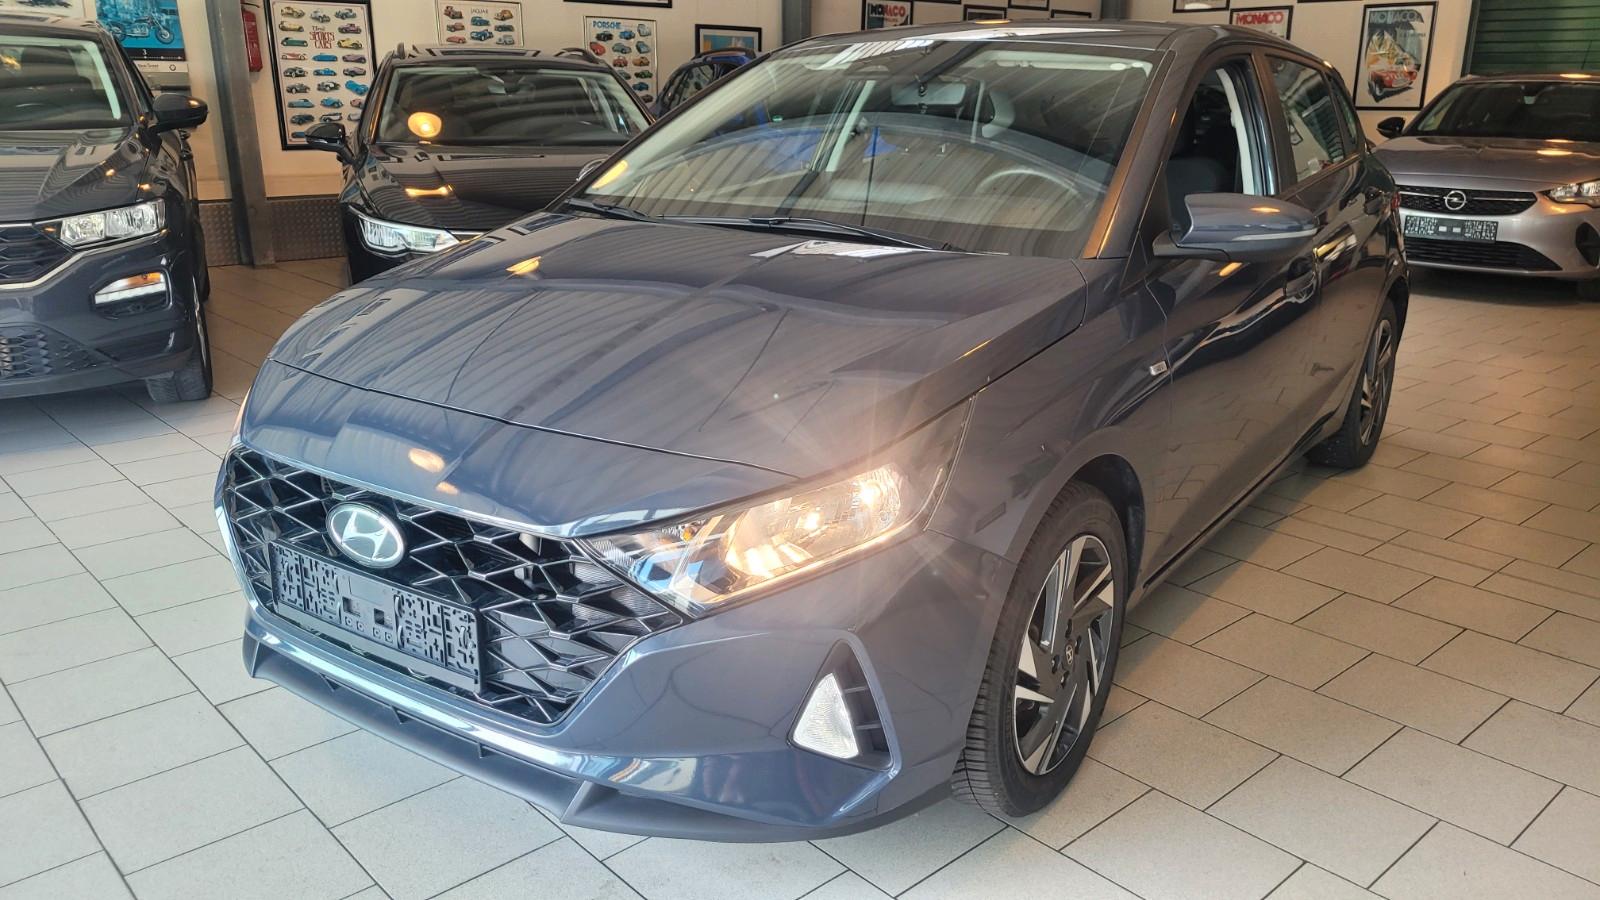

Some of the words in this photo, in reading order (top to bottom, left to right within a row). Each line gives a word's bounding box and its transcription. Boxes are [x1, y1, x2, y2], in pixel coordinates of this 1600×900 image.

[868, 3, 906, 17] MONACO
[1236, 12, 1285, 25] MONACO
[1370, 10, 1417, 24] MONACO
[592, 20, 621, 29] PORSCHE
[309, 31, 336, 41] SPORTS
[314, 40, 332, 49] CARS
